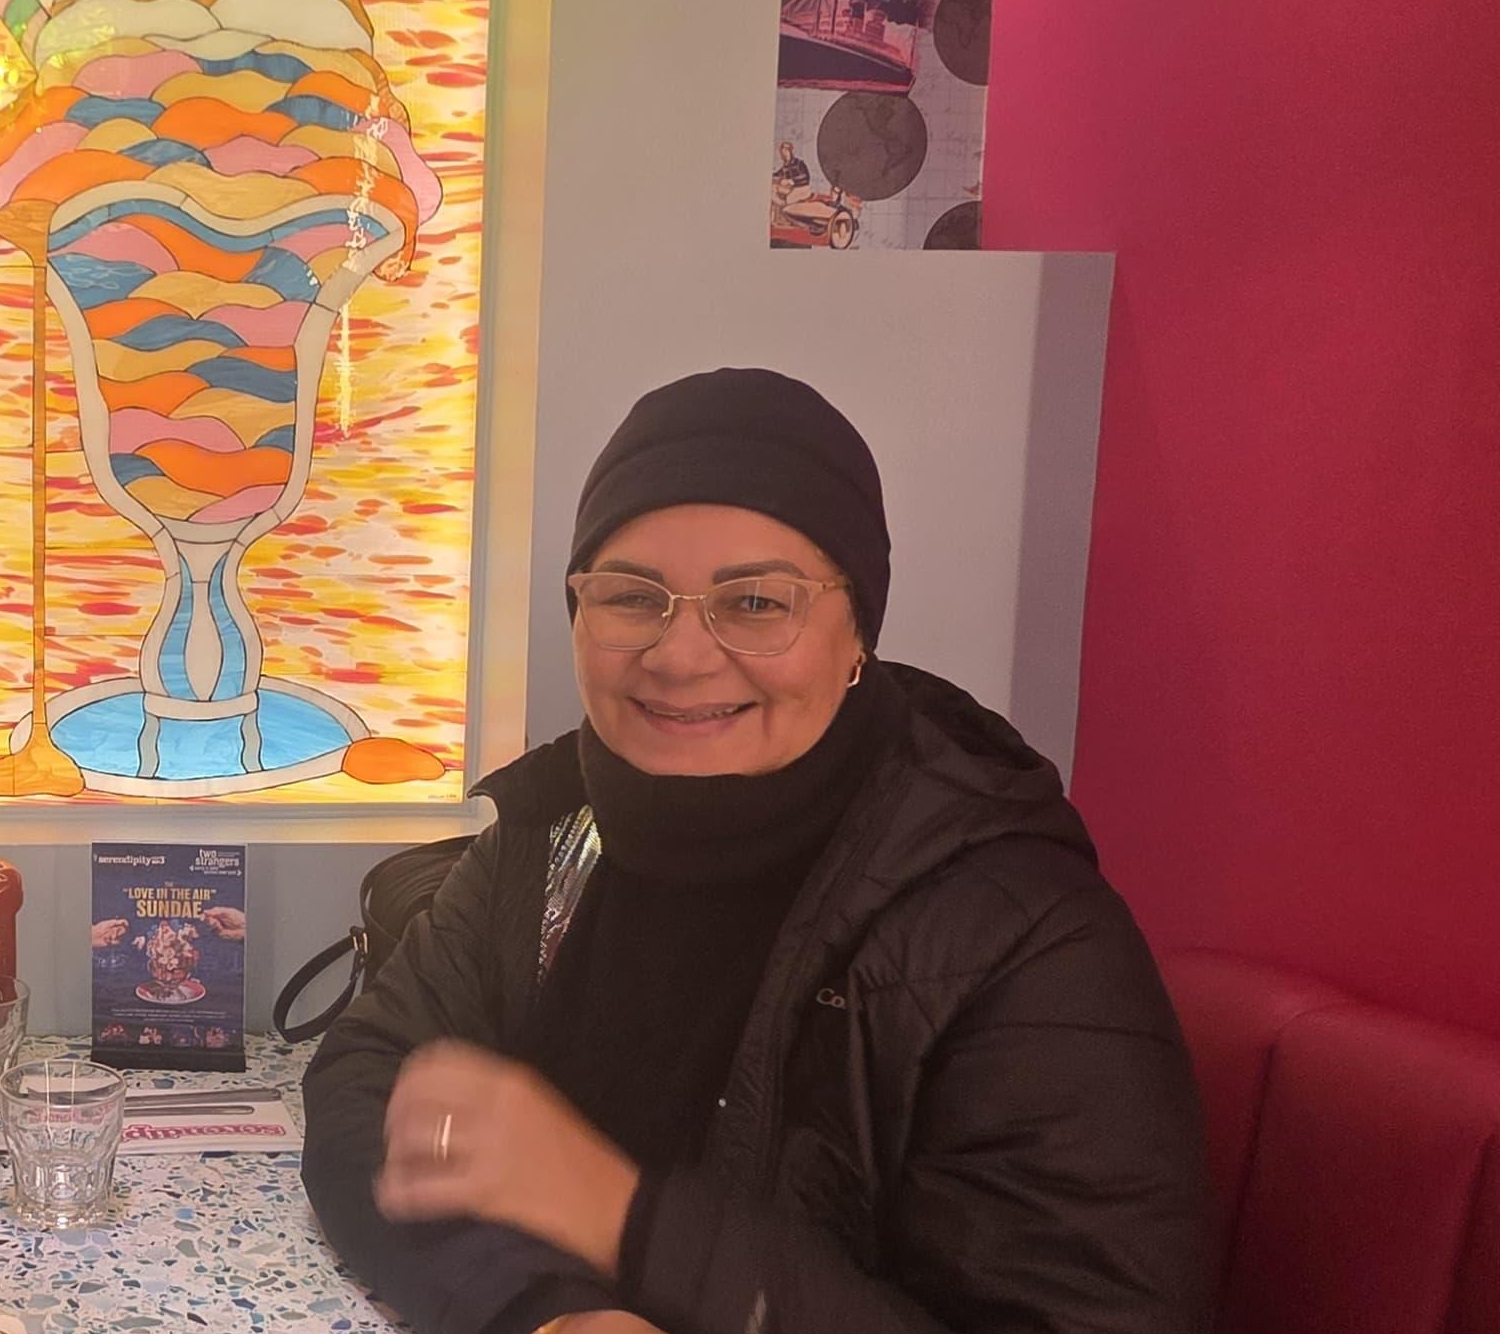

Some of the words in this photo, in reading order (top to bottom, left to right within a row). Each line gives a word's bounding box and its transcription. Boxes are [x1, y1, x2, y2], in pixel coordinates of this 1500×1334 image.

[199, 849, 217, 858] two
[195, 855, 240, 868] strangers
[157, 888, 168, 899] IN
[171, 888, 191, 900] THE
[136, 900, 203, 919] SUNDAE
[121, 1124, 286, 1142] serendip
